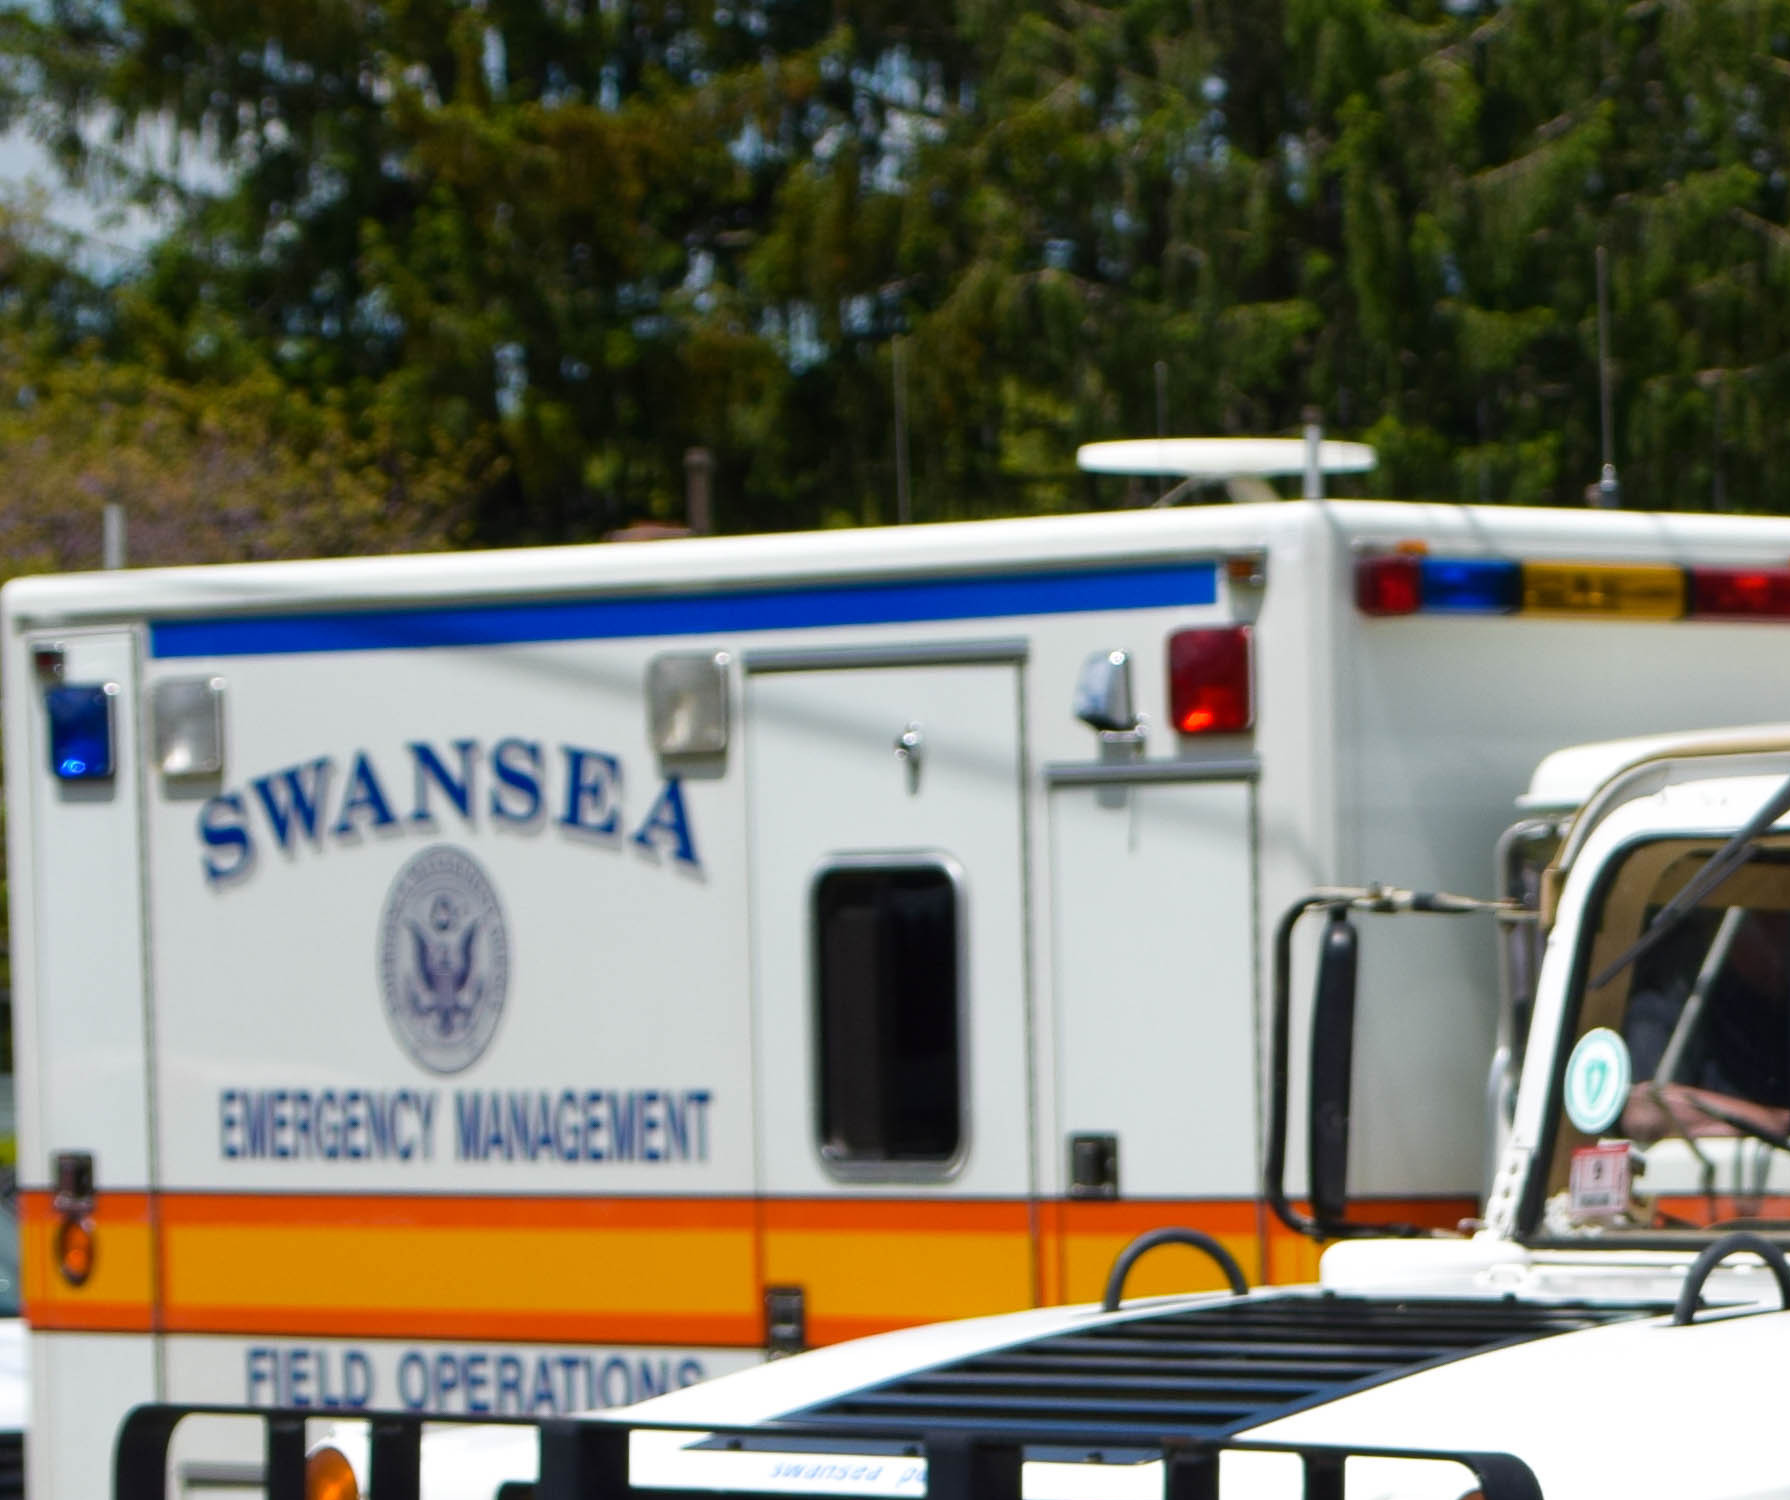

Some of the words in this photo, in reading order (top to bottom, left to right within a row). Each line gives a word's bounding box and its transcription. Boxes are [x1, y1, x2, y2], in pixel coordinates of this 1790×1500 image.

[198, 737, 702, 882] SWANSEA
[220, 1089, 435, 1160] EMERGENCY
[454, 1089, 712, 1161] MANAGEMENT
[247, 1348, 374, 1409] FIELD
